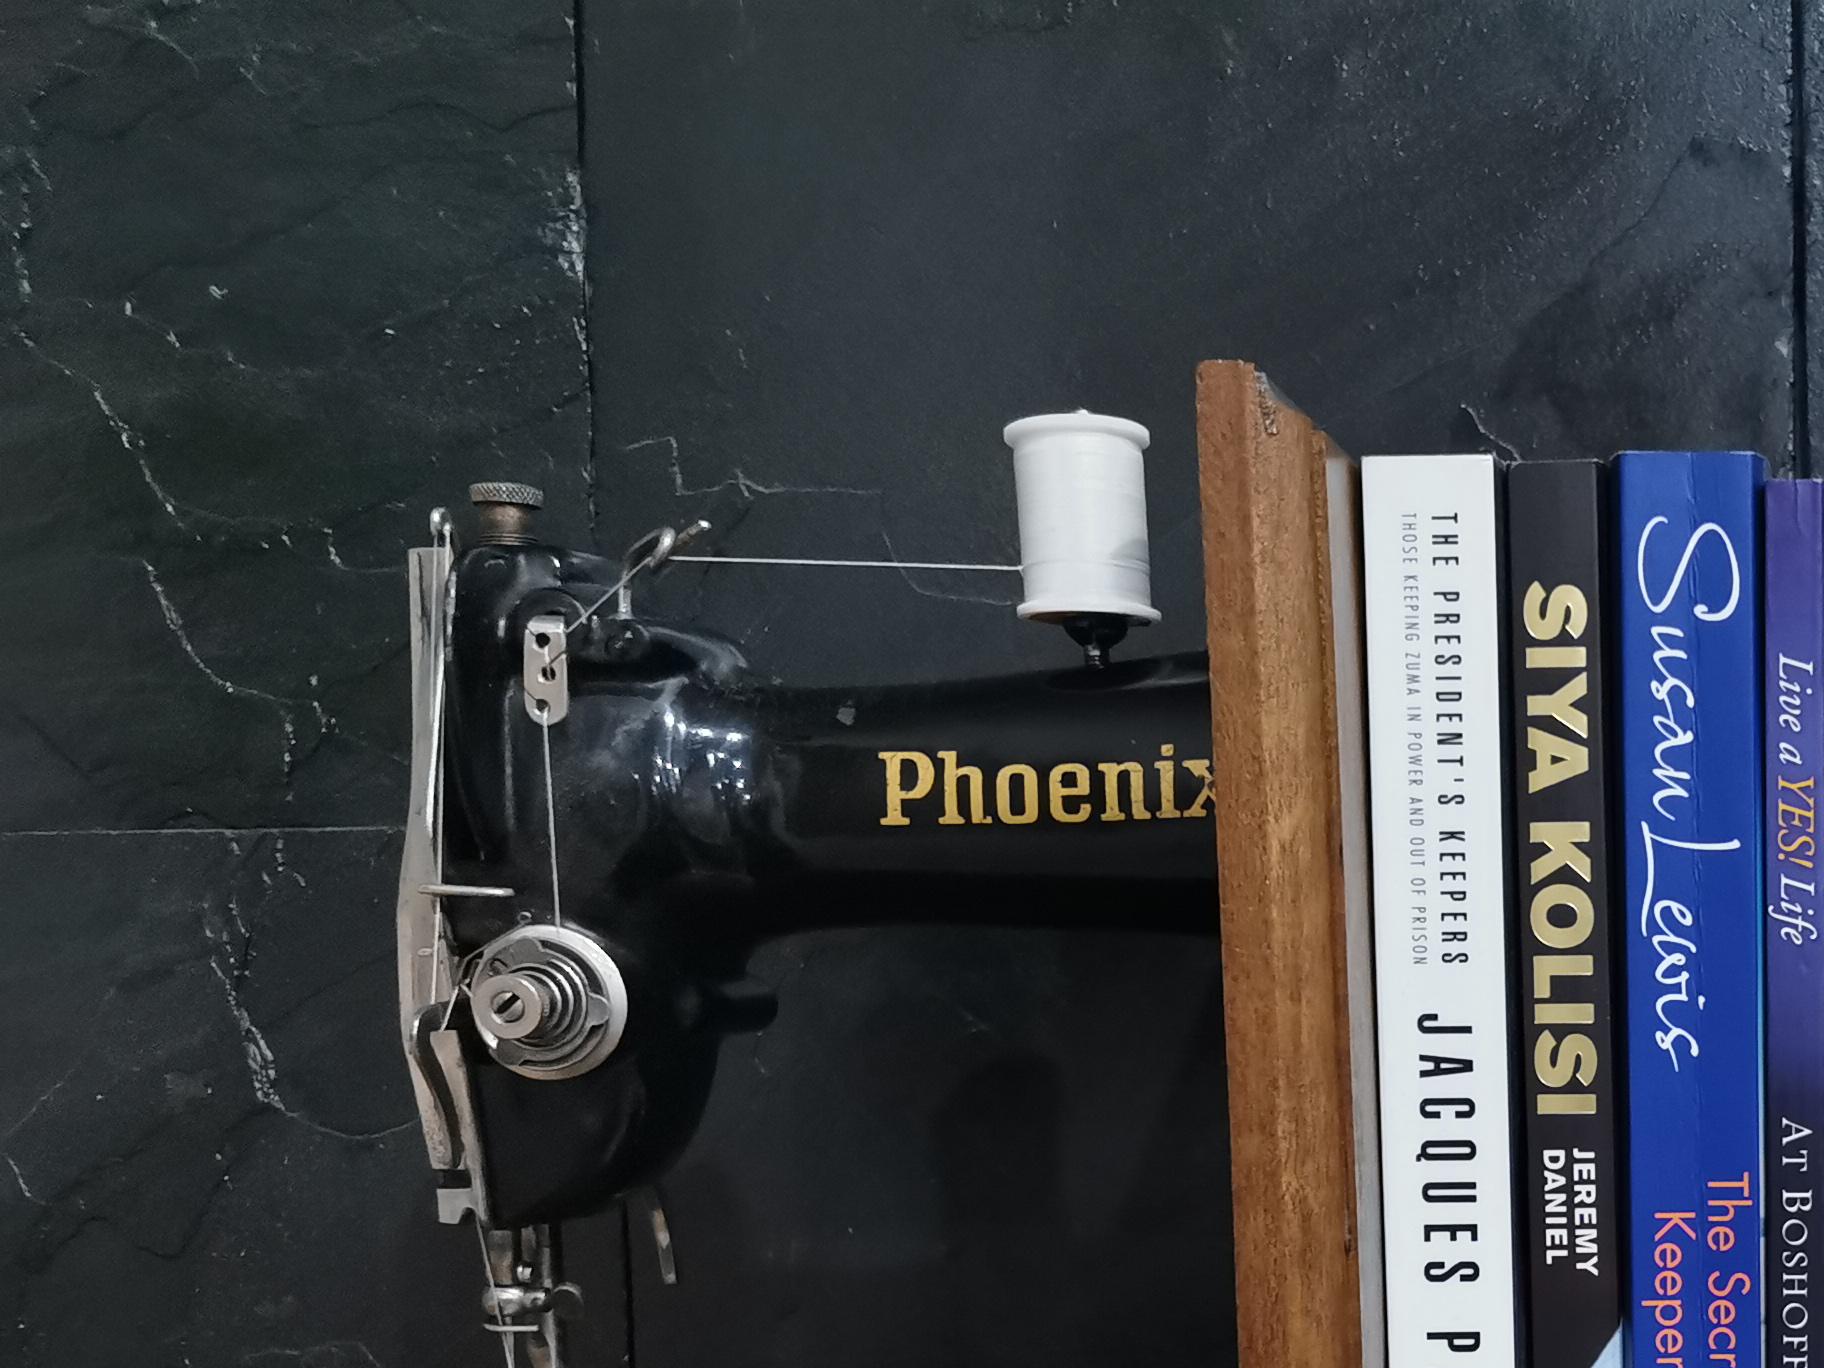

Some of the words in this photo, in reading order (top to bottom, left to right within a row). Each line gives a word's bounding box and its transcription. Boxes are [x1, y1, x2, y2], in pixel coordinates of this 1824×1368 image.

[1402, 513, 1418, 563] THOSE
[1432, 513, 1459, 566] THE
[1404, 575, 1420, 641] KEEPING
[1405, 653, 1421, 695] ZUMA
[1433, 592, 1465, 805] PRESIDENT'S
[1523, 581, 1589, 793] SIYA
[1638, 516, 1740, 820] Susan
[1779, 653, 1813, 732] Live
[1407, 707, 1421, 721] IN
[1408, 733, 1423, 785] POWER
[1779, 742, 1802, 764] a
[1409, 797, 1424, 826] AND
[1778, 776, 1816, 868] YES!
[1410, 837, 1425, 866] OUT
[1411, 878, 1426, 895] OF
[1439, 831, 1469, 963] KEEPERS
[1769, 874, 1817, 945] Life
[1412, 908, 1427, 964] PRISON
[1530, 821, 1597, 1114] KOLISI
[1641, 821, 1740, 1072] Lewis
[1416, 1014, 1480, 1282] JACQUES
[1782, 1117, 1812, 1171] AT
[1543, 1150, 1566, 1264] DANIEL
[1573, 1148, 1598, 1276] JEREMY
[1707, 1172, 1752, 1251] The
